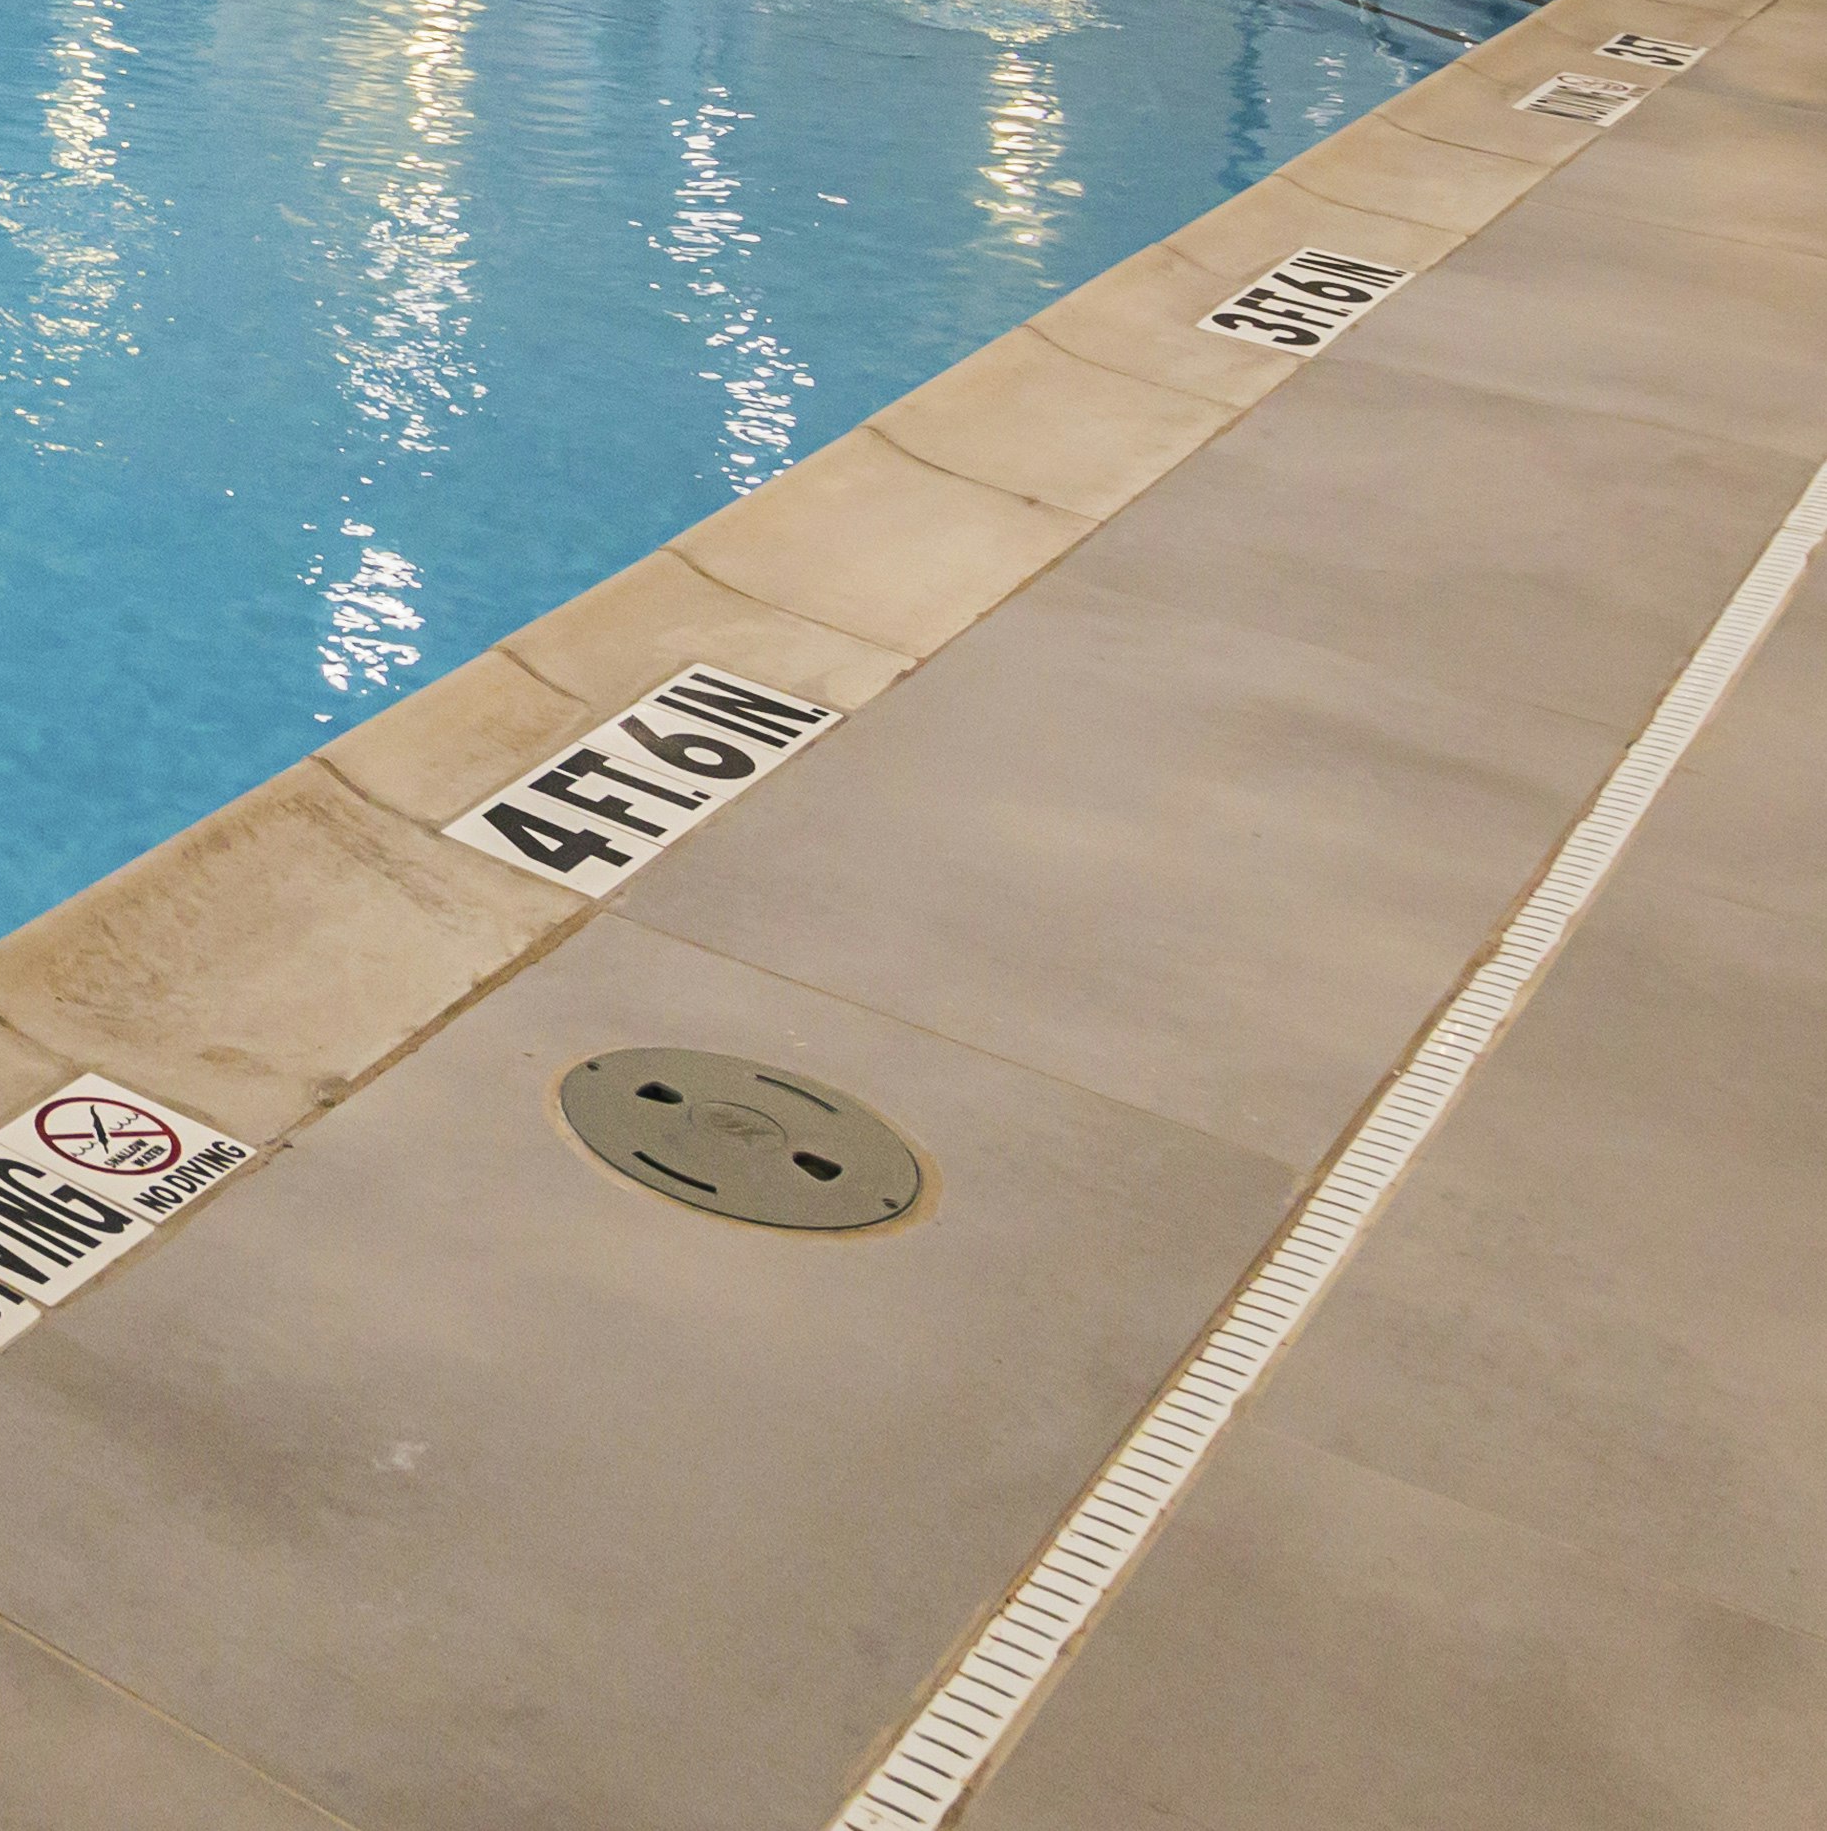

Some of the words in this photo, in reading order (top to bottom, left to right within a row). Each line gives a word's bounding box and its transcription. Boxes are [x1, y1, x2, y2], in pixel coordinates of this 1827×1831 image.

[1602, 47, 1685, 66] 3
[1271, 272, 1373, 303] 6
[1289, 251, 1407, 289] IN.
[1233, 287, 1353, 329] FT.
[1211, 313, 1321, 346] 3
[653, 672, 830, 749] IN.
[617, 714, 757, 780] 6
[527, 748, 712, 838] FT.
[481, 802, 634, 874] 4
[130, 1144, 169, 1168] WATER
[133, 1185, 184, 1214] NO
[162, 1141, 247, 1194] DIVING
